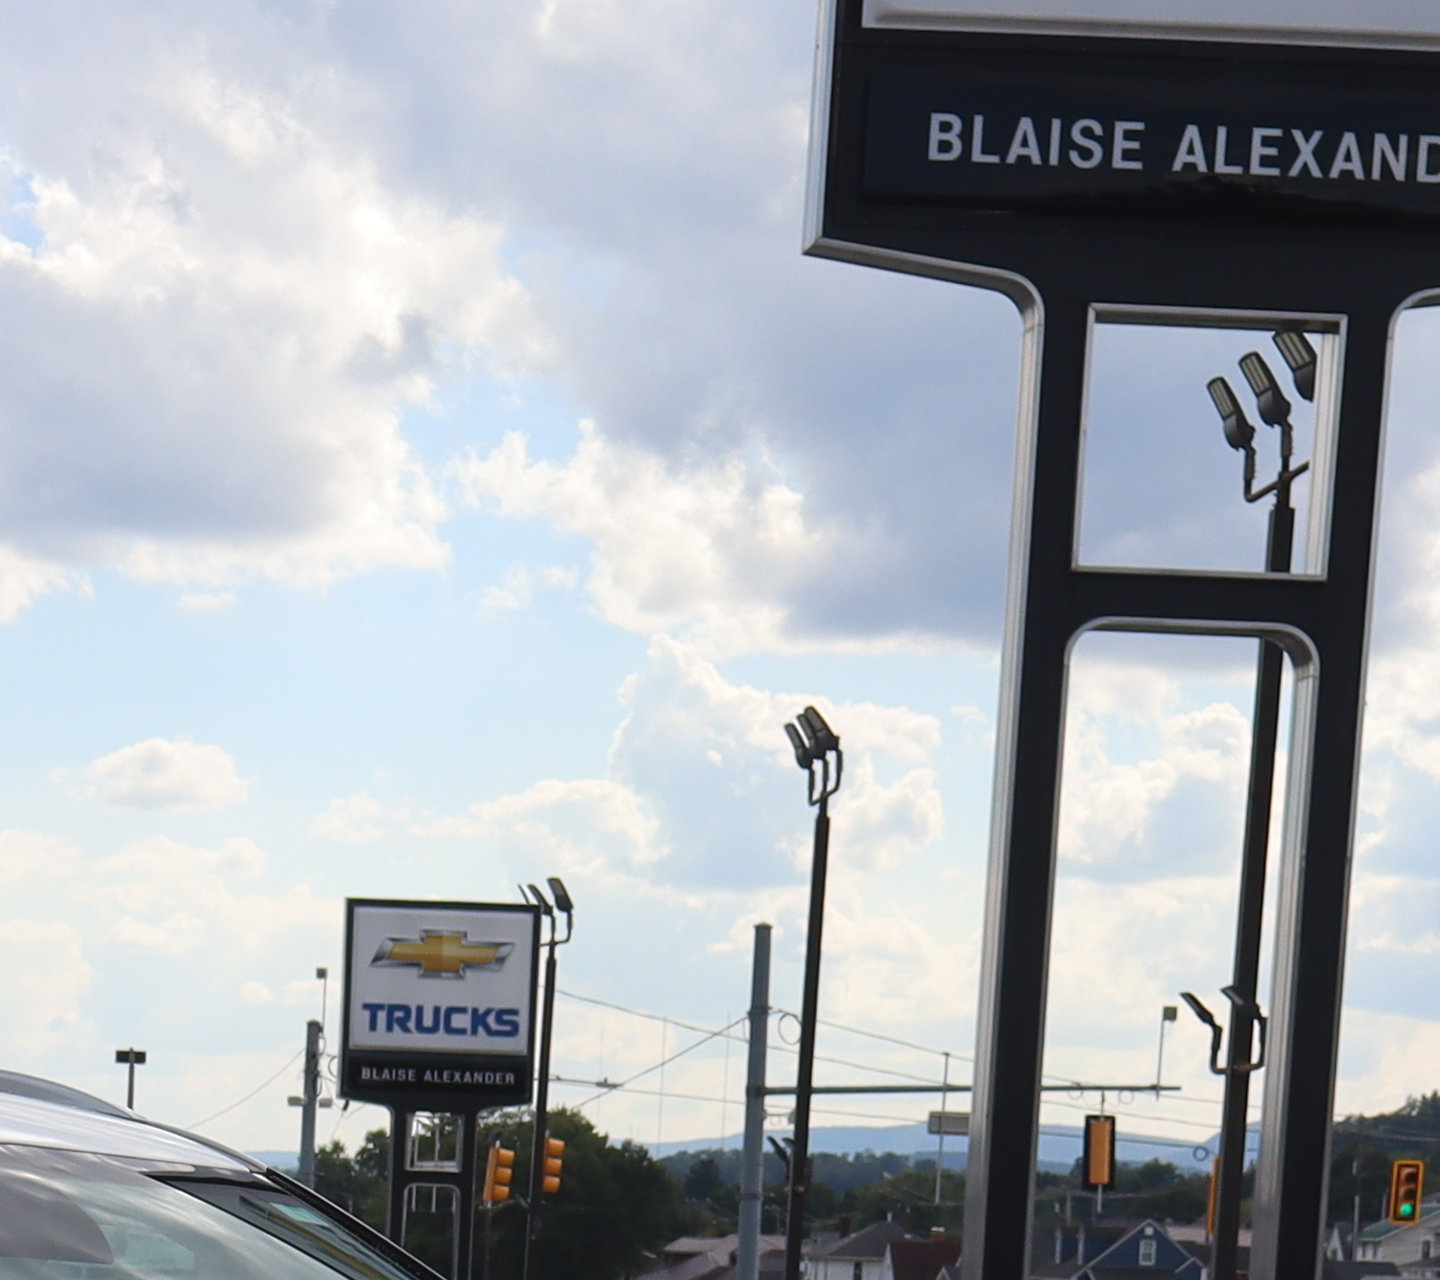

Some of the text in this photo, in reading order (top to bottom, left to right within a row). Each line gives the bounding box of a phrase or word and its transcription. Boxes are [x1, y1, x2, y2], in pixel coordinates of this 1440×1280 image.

[927, 112, 1146, 171] BLAISE
[362, 1003, 520, 1038] TRUCKS
[360, 1067, 515, 1085] BLAISE ALEXANDER
